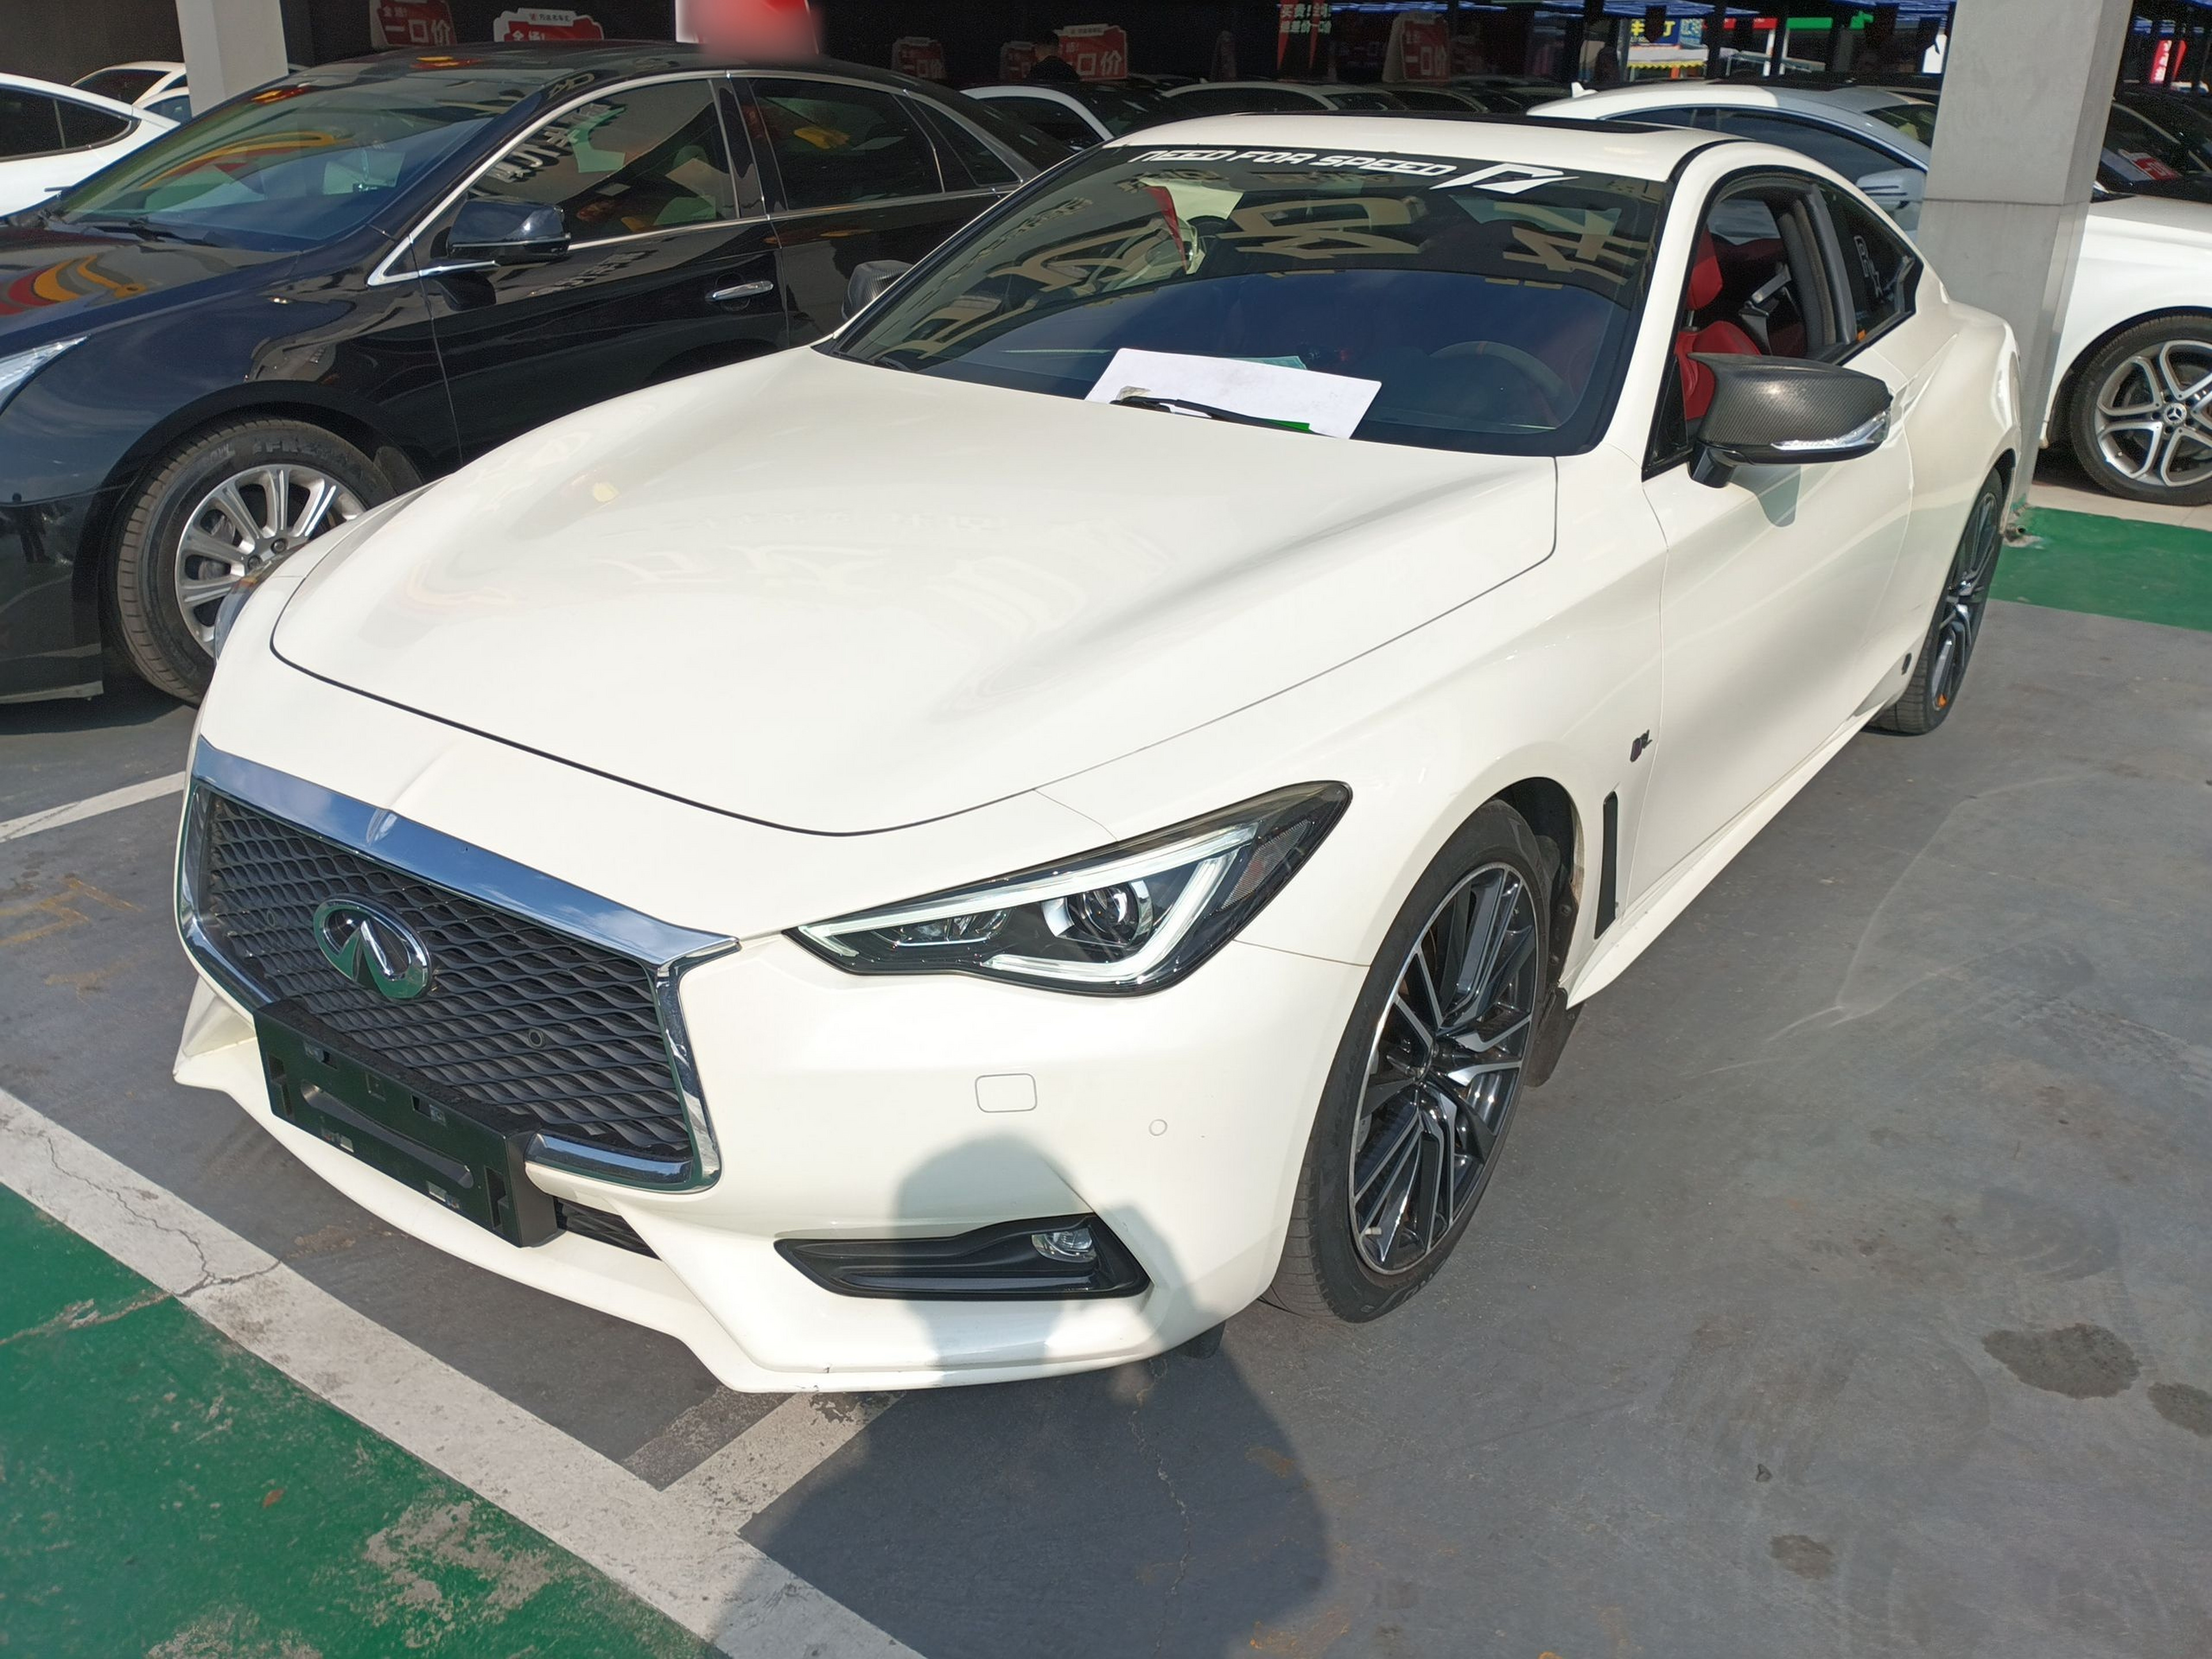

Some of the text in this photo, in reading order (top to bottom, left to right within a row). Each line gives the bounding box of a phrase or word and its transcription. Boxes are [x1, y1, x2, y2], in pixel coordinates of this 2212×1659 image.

[385, 18, 451, 46] 一口价
[1127, 150, 1457, 176] NEED FOR SPEED
